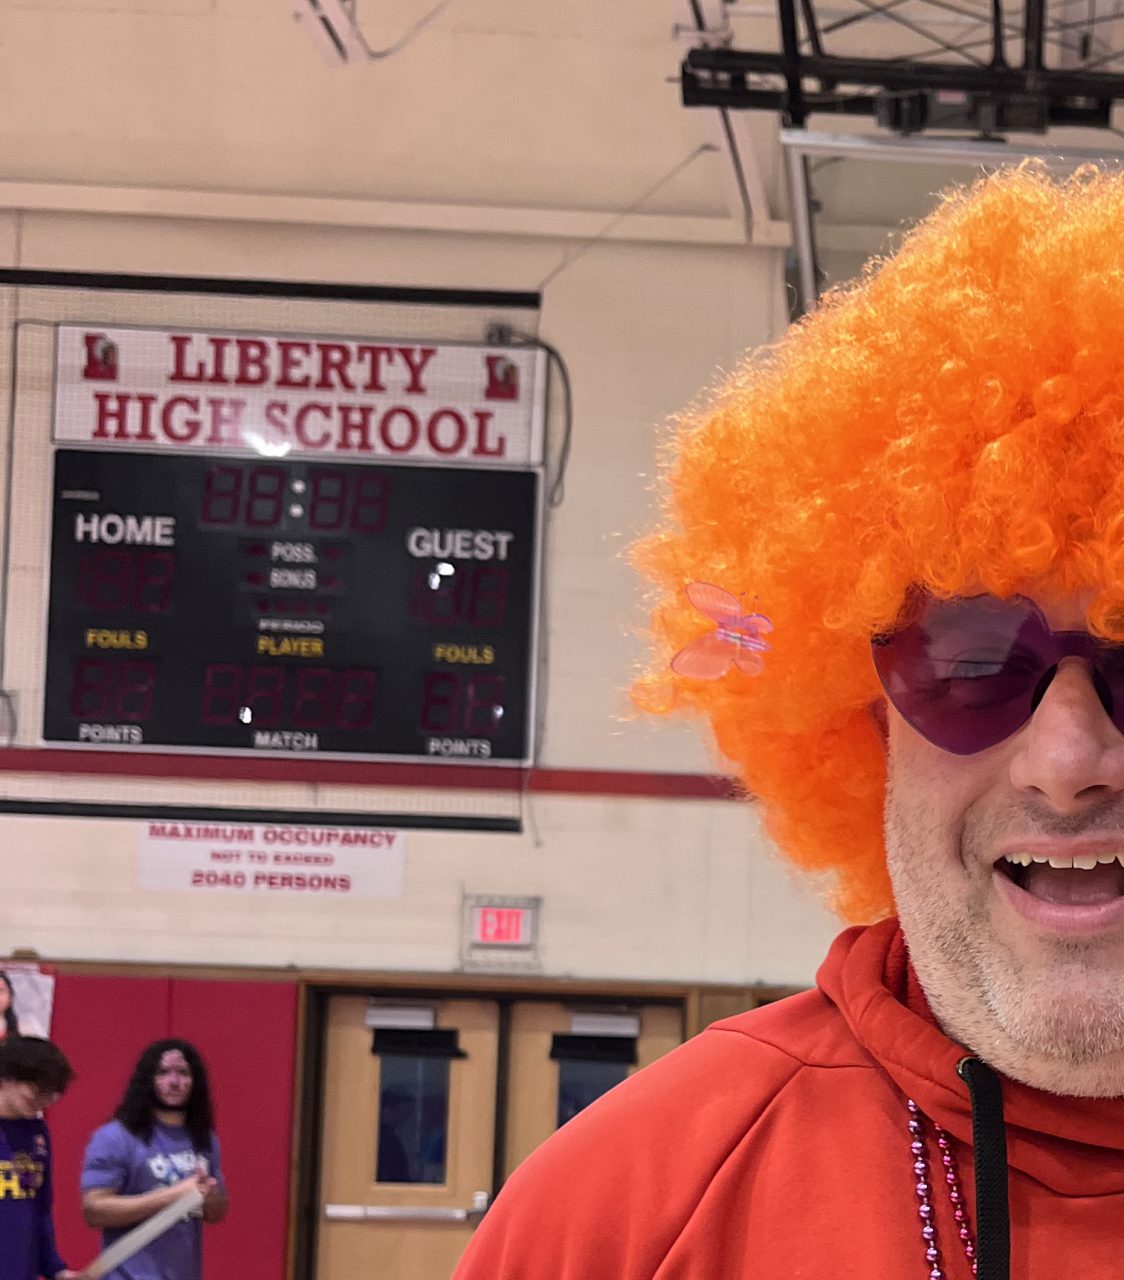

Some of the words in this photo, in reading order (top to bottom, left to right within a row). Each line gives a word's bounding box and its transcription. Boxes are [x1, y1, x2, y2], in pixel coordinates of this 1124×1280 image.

[169, 335, 437, 394] LIBERTY
[92, 391, 247, 445] HIGH
[264, 401, 507, 457] SCHOOL
[75, 513, 176, 546] HOME
[407, 527, 514, 560] GUEST
[270, 568, 317, 590] BONUS
[86, 629, 149, 650] FOULS
[257, 636, 325, 658] PLAYER
[434, 643, 495, 664] FOULS
[78, 723, 143, 744] POINTS
[254, 730, 319, 751] MATCH
[428, 737, 492, 758] POINTS
[149, 824, 255, 842] MAXIMUM
[263, 828, 397, 848] OCCUPANCY
[191, 870, 246, 888] 2040
[253, 872, 352, 892] PERSONS
[480, 907, 522, 943] EXIT
